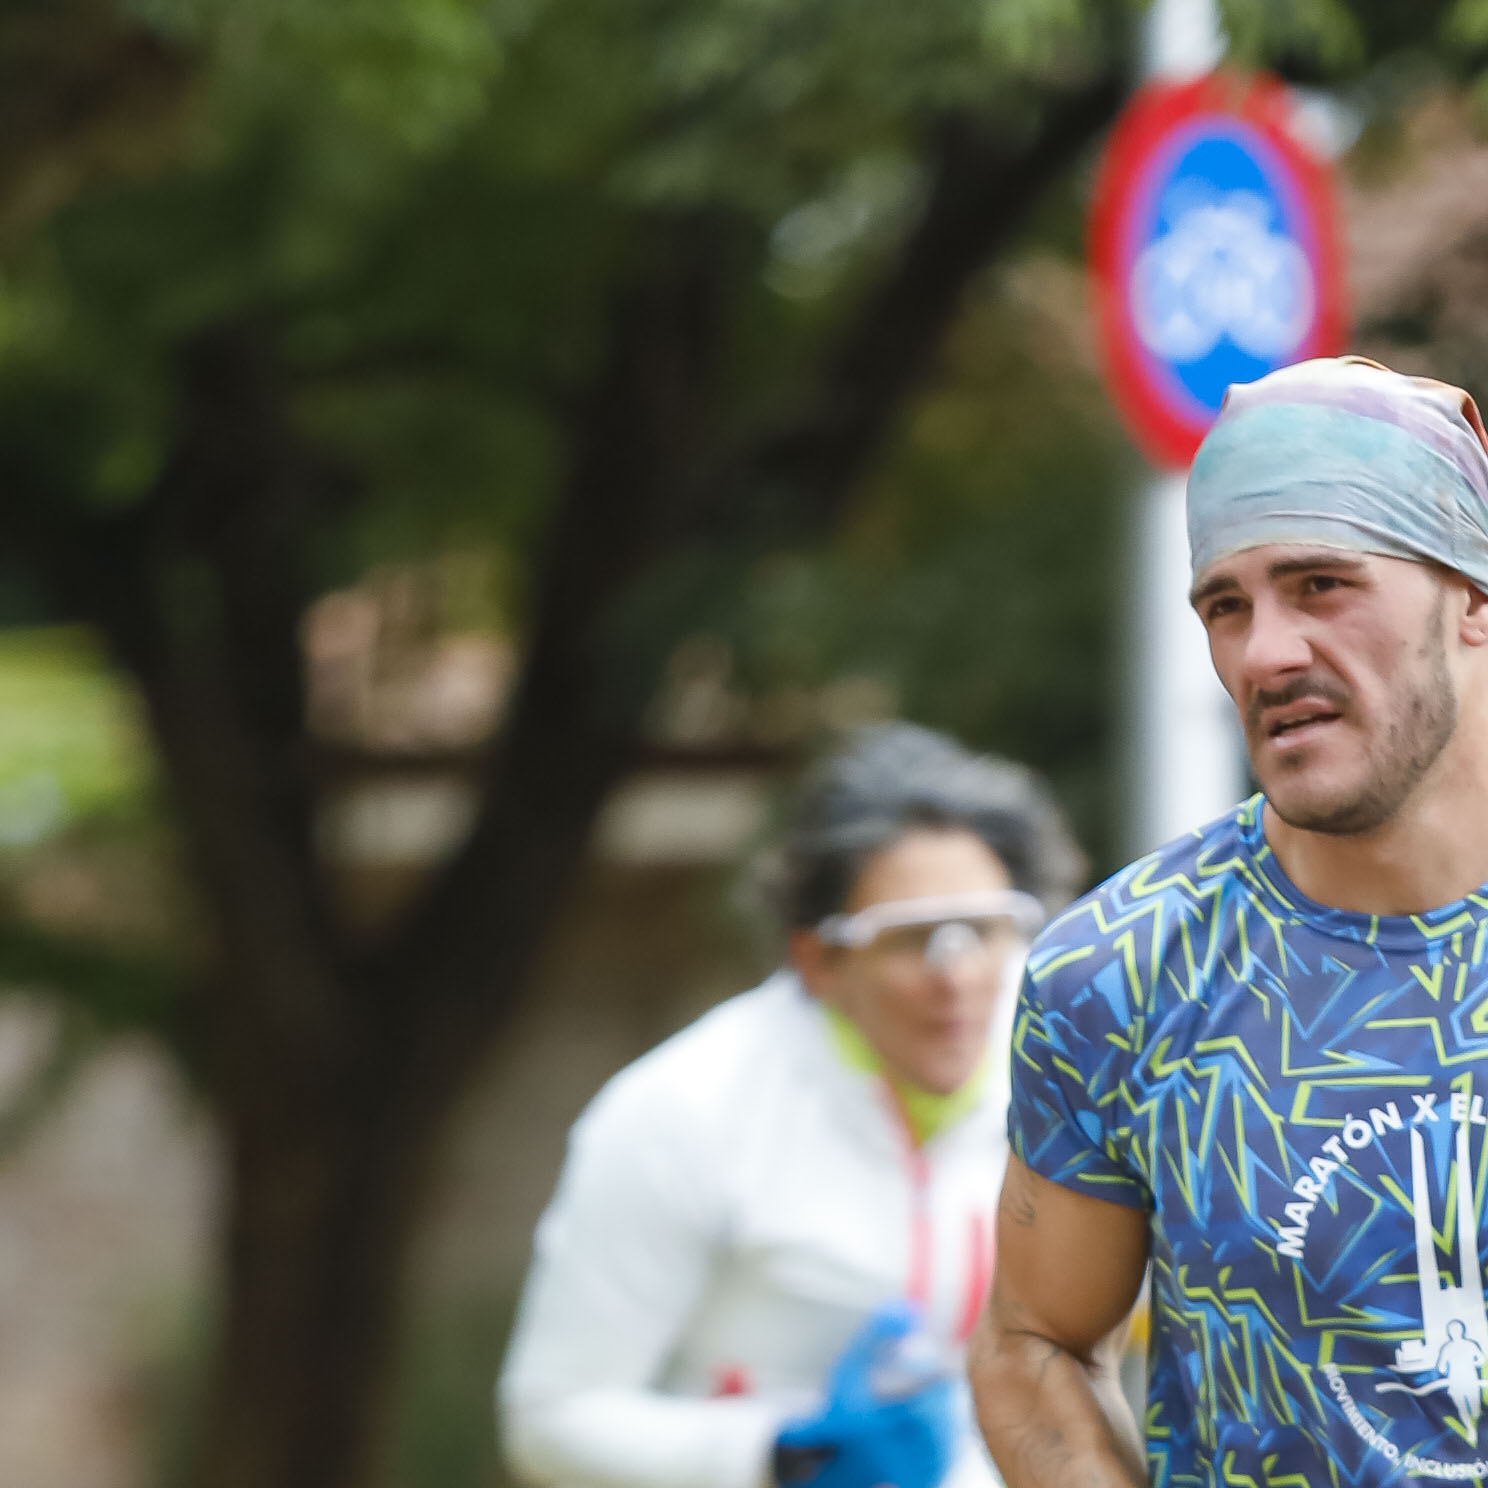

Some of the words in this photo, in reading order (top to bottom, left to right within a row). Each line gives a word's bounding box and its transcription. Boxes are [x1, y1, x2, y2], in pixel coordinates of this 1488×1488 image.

[1276, 1100, 1404, 1260] MARATÓN
[1410, 1092, 1441, 1124] X
[1449, 1091, 1488, 1126] EL
